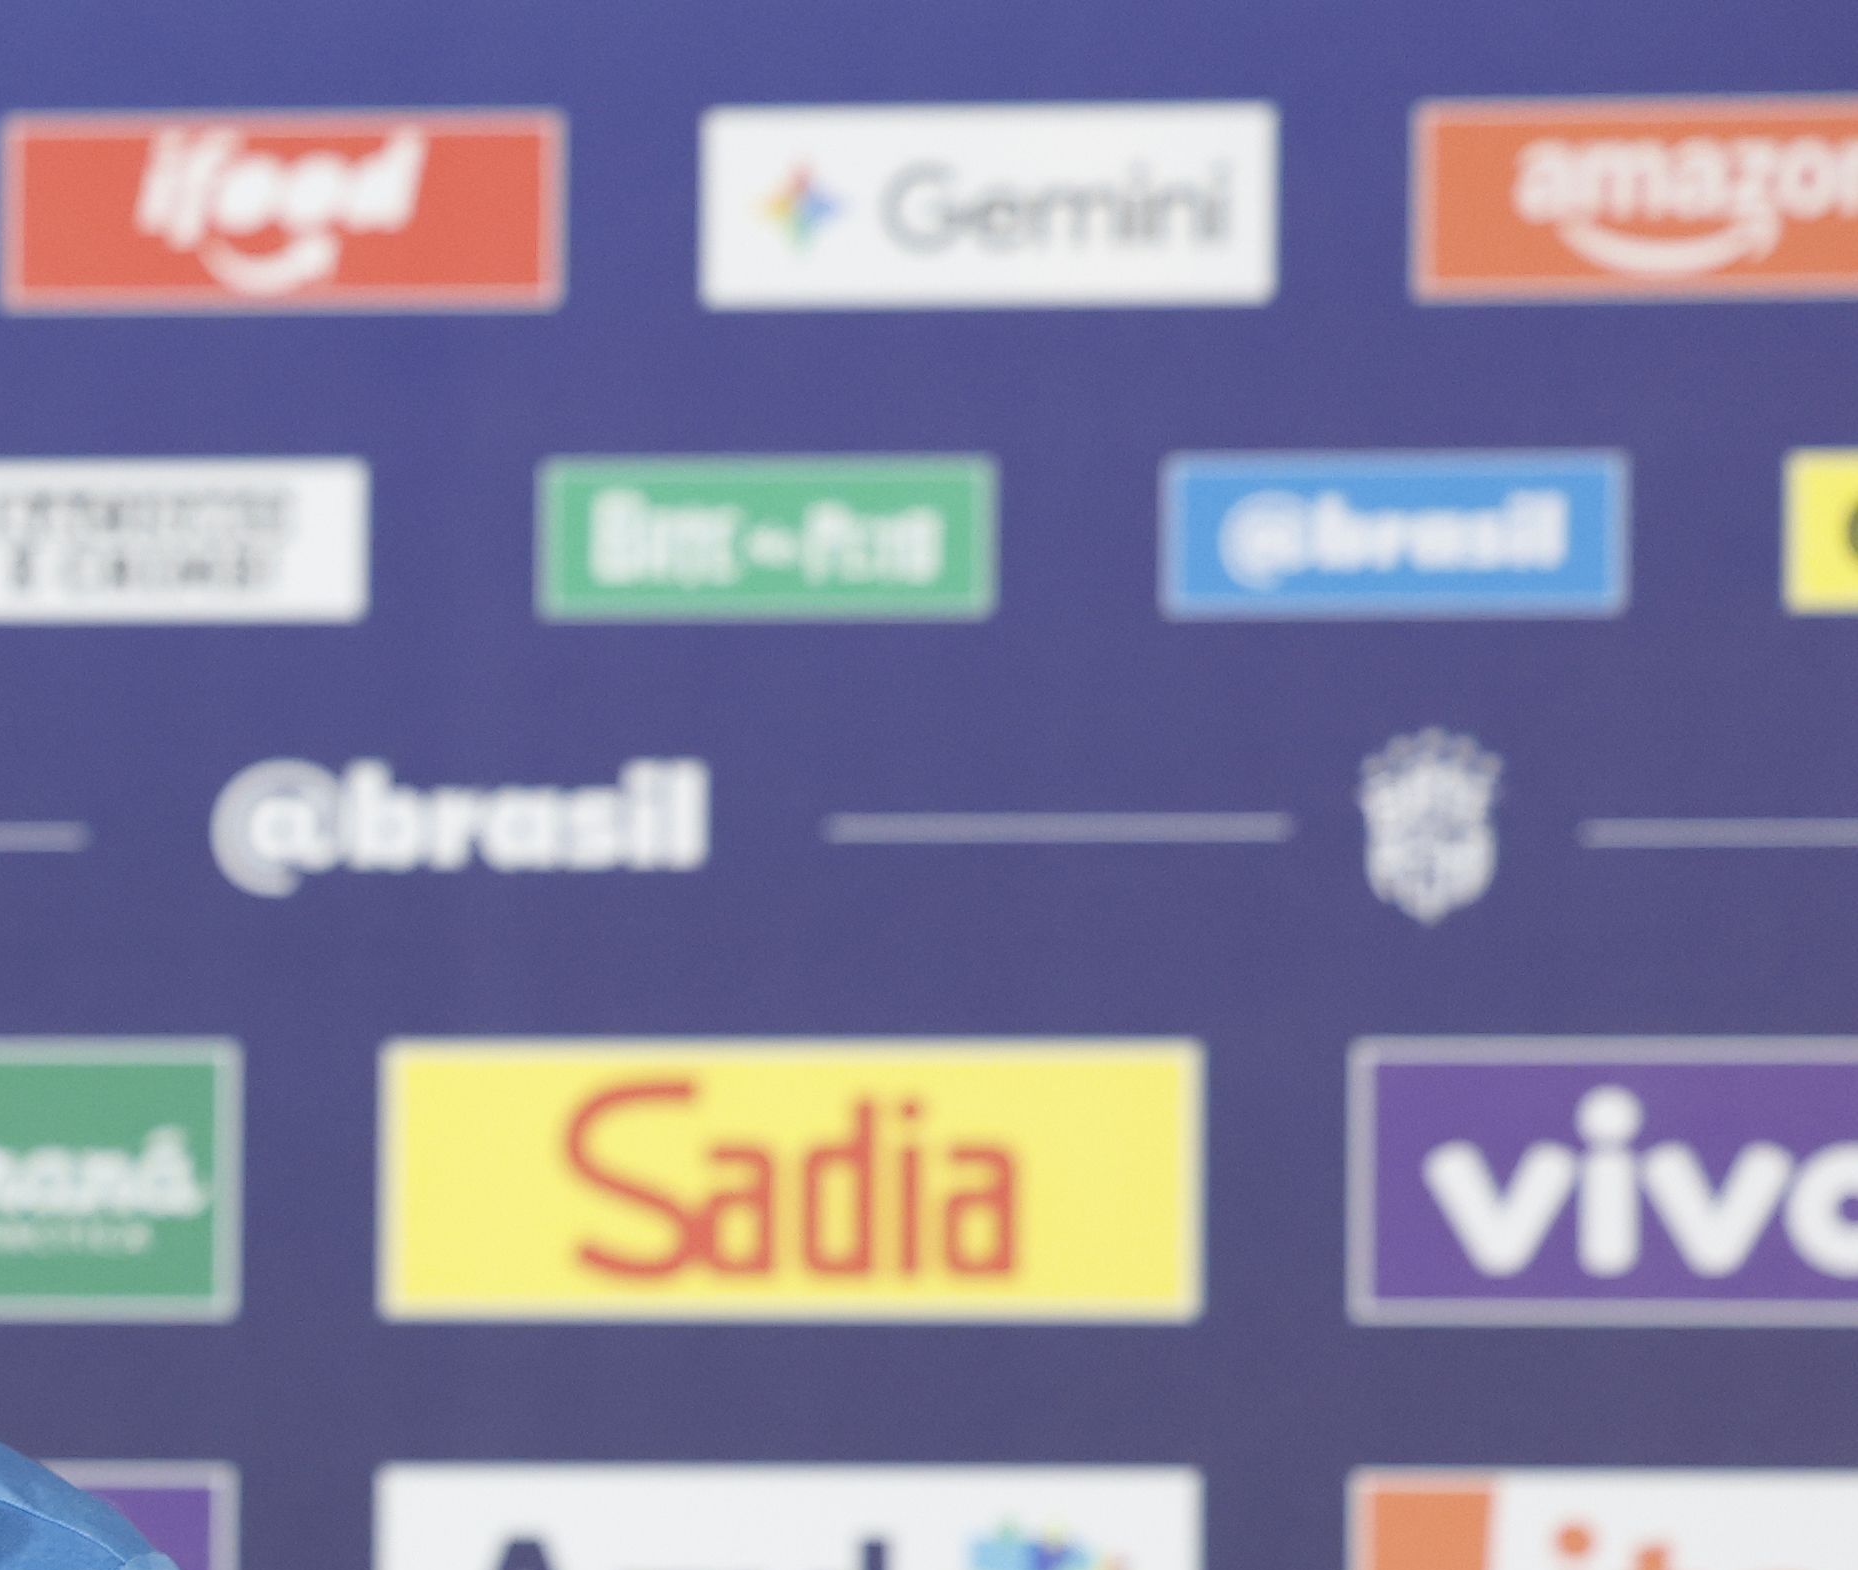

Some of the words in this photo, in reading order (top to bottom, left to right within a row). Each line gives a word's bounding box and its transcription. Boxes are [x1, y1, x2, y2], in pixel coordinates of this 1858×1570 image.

[881, 157, 1232, 253] Gemini
[1219, 487, 1572, 588] @brasil
[210, 756, 711, 897] @brasil
[565, 1077, 1021, 1280] Sadia
